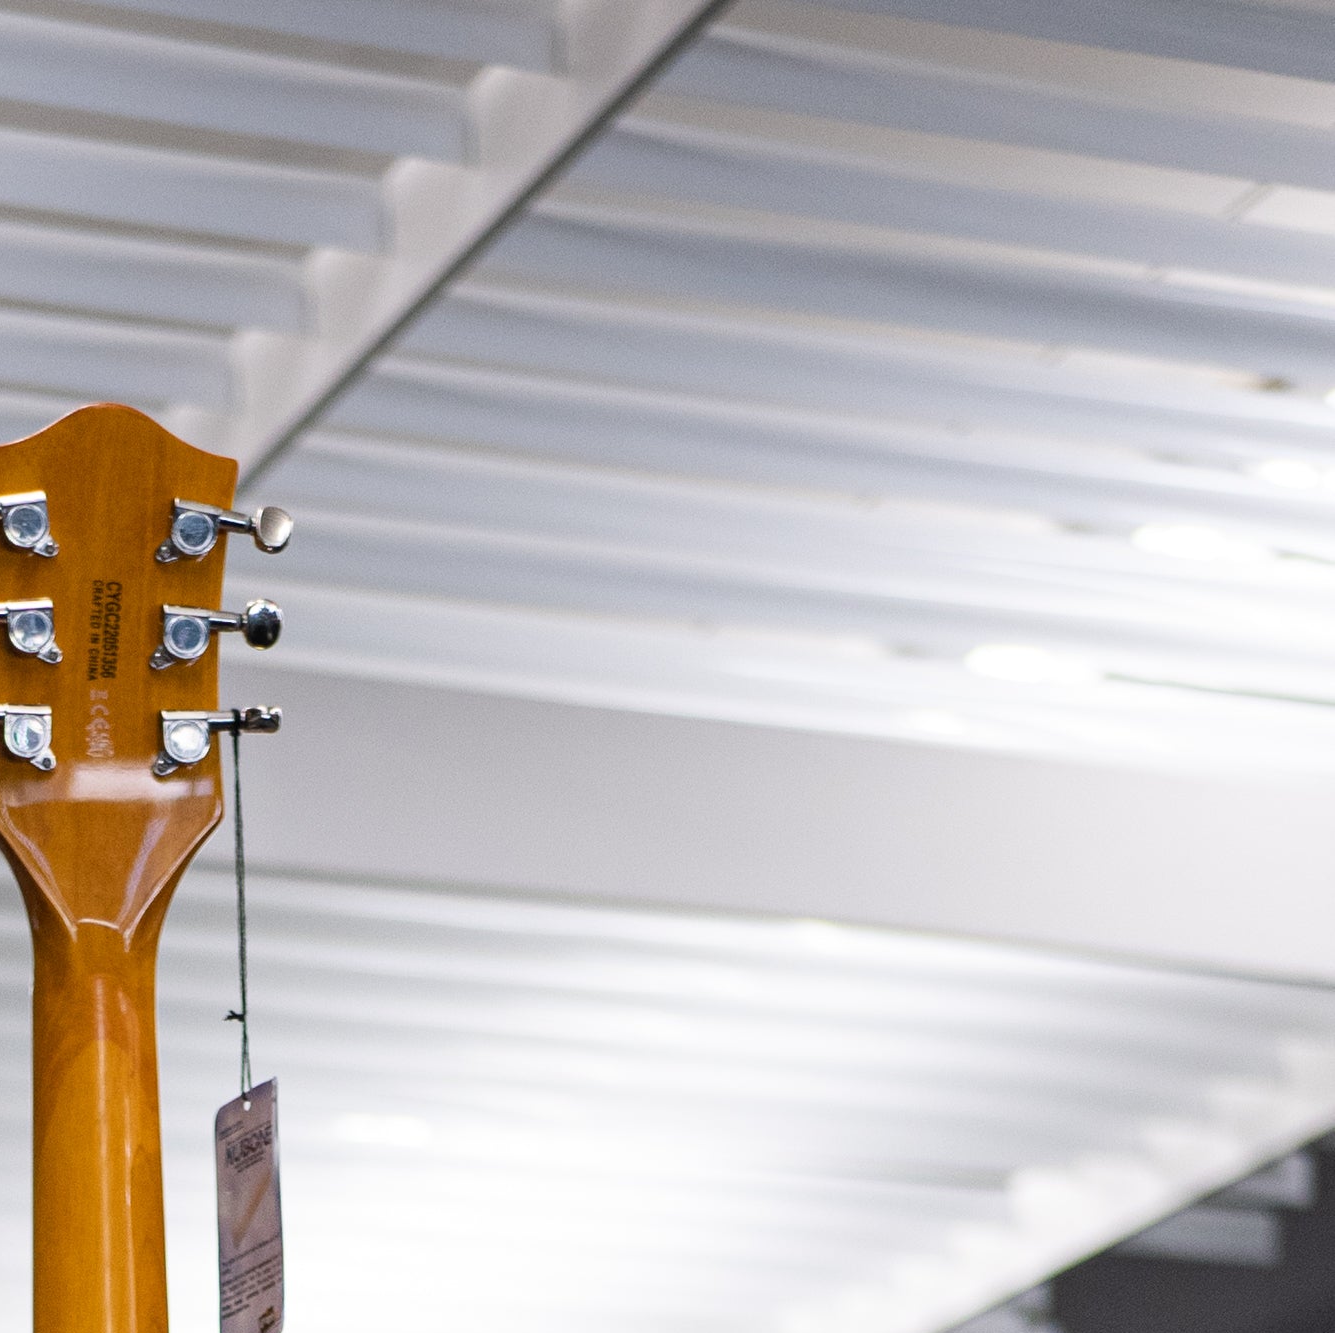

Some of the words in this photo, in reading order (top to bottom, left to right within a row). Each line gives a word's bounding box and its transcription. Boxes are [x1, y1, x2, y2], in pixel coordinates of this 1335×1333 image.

[90, 579, 103, 630] CRAFTED
[89, 633, 101, 645] IN
[86, 648, 100, 682] CHINA
